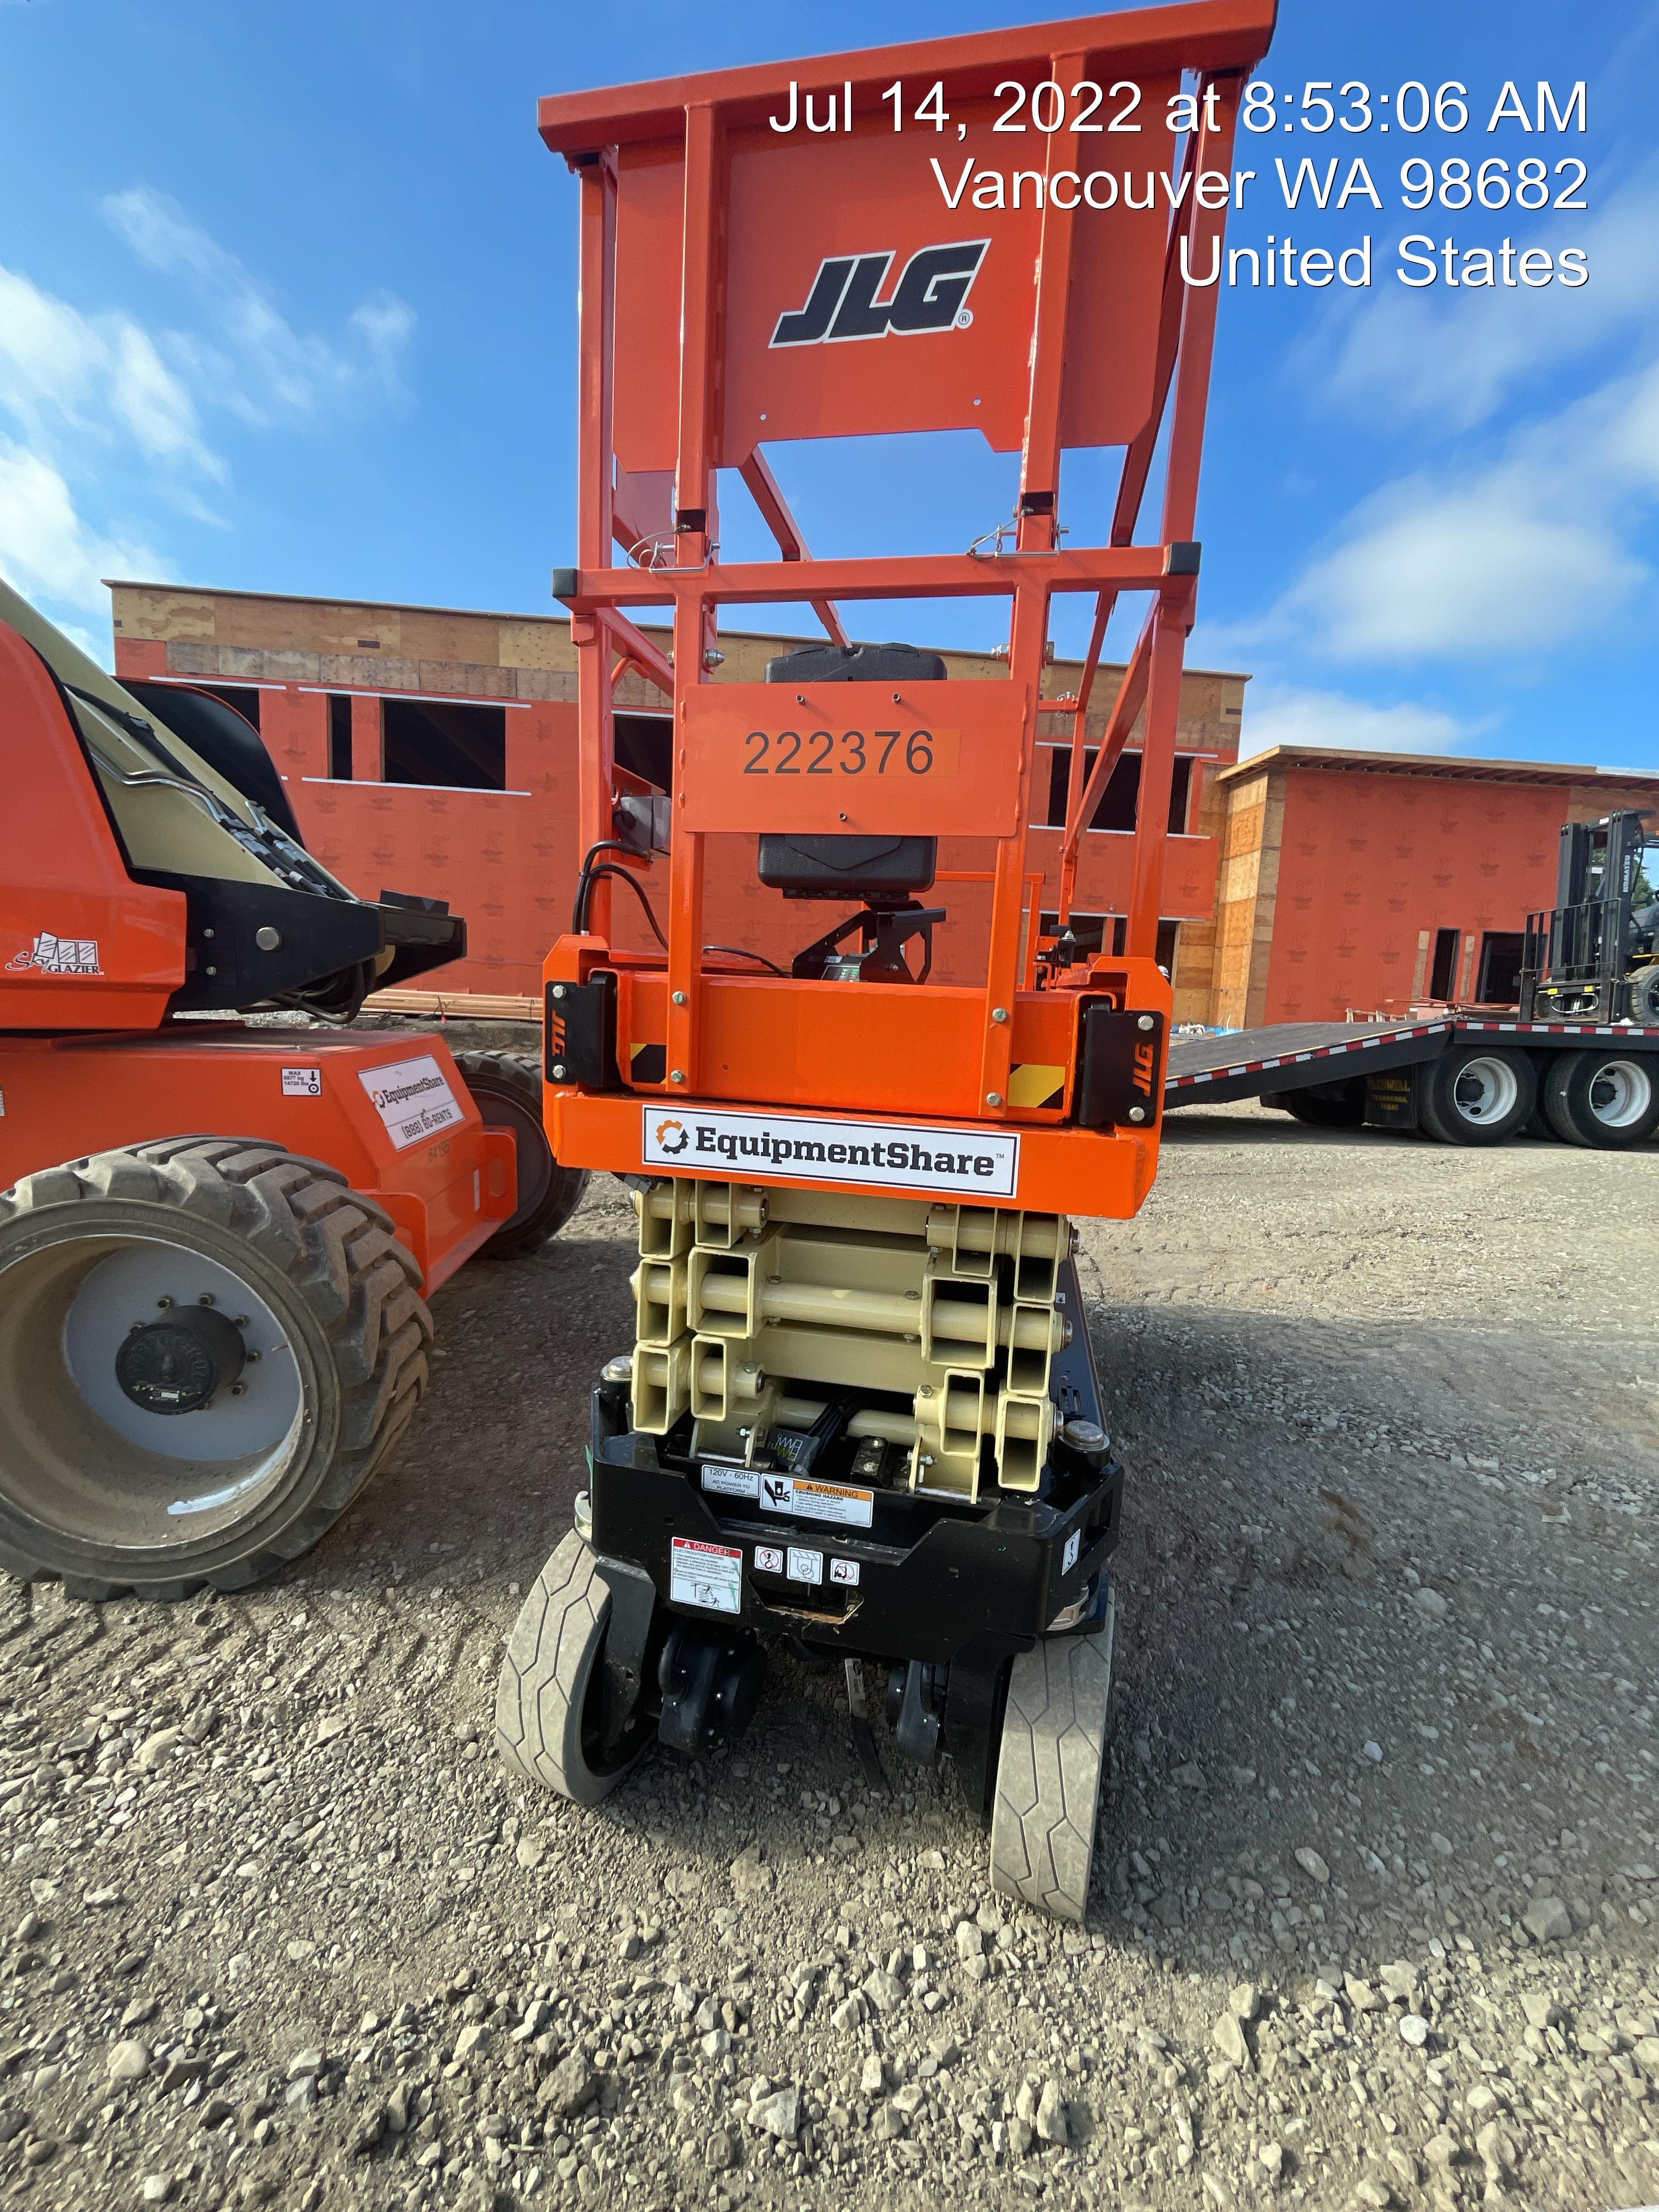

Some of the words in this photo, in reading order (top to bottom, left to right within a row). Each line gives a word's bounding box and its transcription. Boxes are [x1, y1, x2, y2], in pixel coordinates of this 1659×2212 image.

[743, 730, 934, 775] 222376
[47, 964, 100, 974] GLAZIER
[551, 1008, 566, 1058] JLG
[1132, 1042, 1154, 1098] JLG
[382, 1076, 444, 1104] EquipmentShare
[401, 1120, 425, 1139] (888)
[709, 1469, 728, 1477] 120V
[734, 1472, 754, 1481] 60Hz
[716, 1485, 746, 1493] PLATFORM
[815, 1484, 859, 1498] WARNING
[693, 1543, 731, 1556] DANGER
